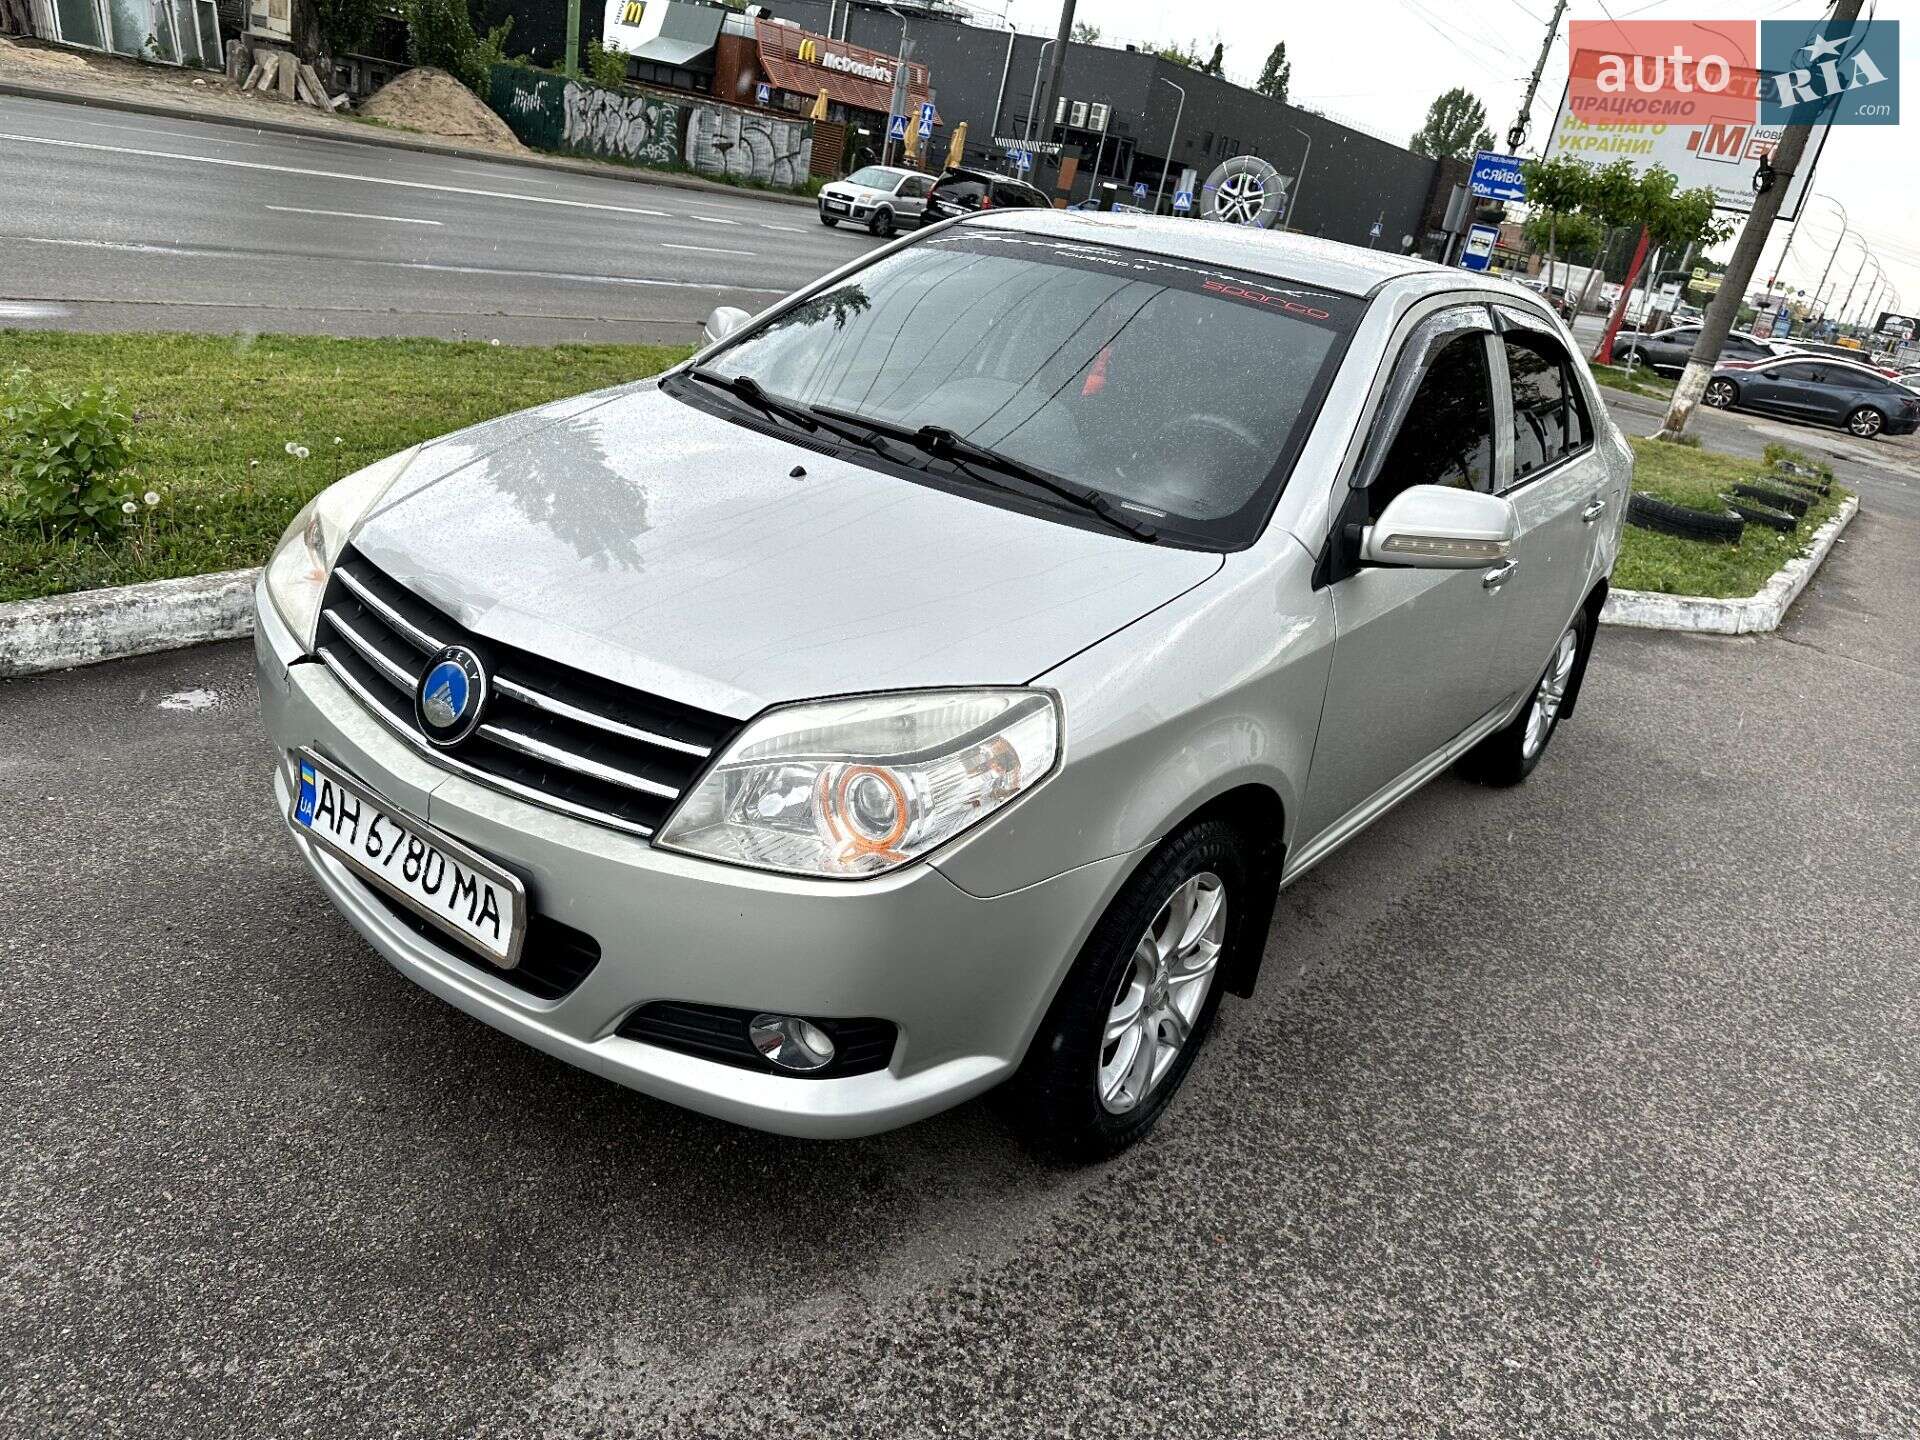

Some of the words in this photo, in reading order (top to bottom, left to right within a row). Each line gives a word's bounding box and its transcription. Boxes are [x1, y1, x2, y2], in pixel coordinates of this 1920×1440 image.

[822, 52, 893, 82] McDonald's
[1569, 95, 1696, 116] ПРАЦЮЄМО
[1563, 115, 1590, 131] НА
[1558, 133, 1656, 155] УКРАЇНИ!
[300, 796, 313, 817] UA
[315, 778, 361, 845] AH
[365, 813, 446, 895] 6780
[448, 861, 501, 940] MA
